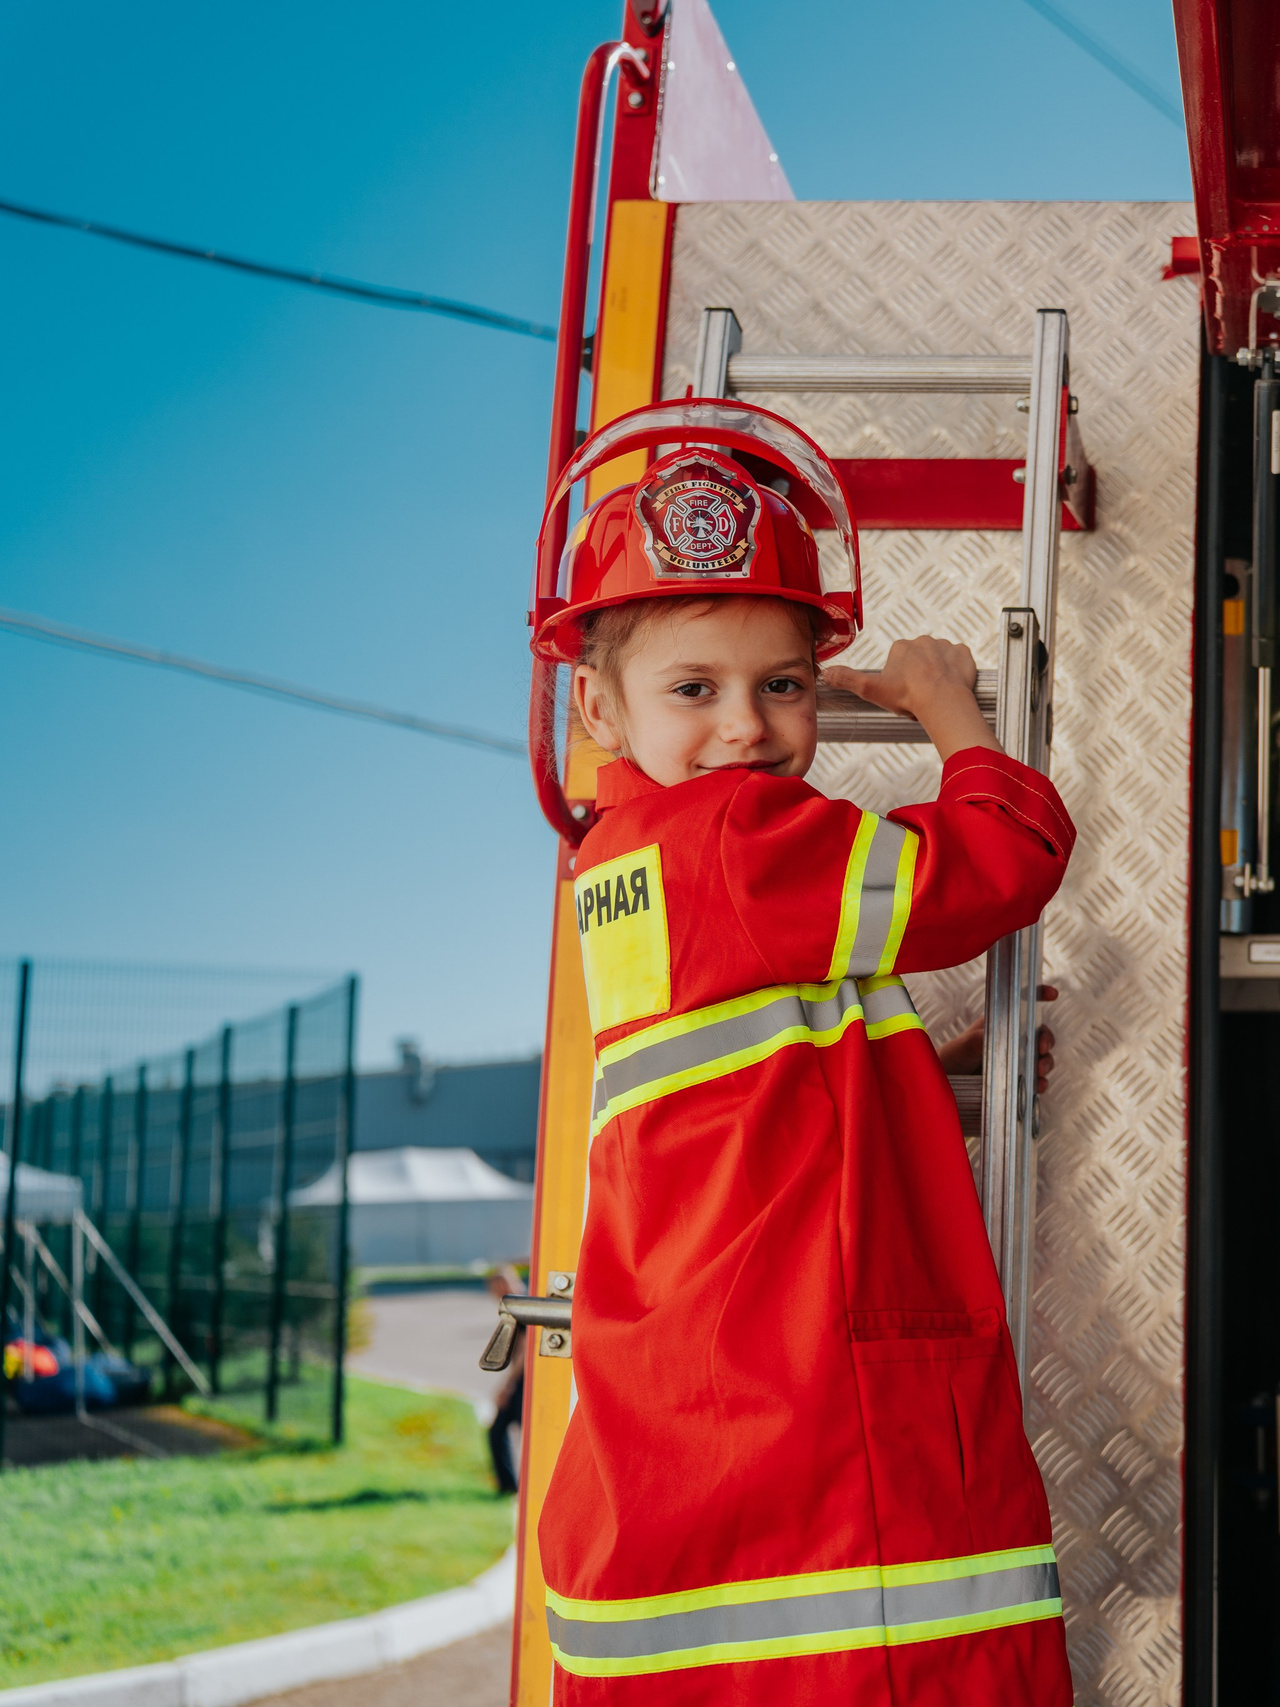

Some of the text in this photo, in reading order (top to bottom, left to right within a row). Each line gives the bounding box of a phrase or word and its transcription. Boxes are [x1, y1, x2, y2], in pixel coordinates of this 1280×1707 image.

[664, 481, 737, 500] FIRE FIGHTER
[672, 517, 729, 532] F D
[669, 553, 738, 569] VOLUNTEER
